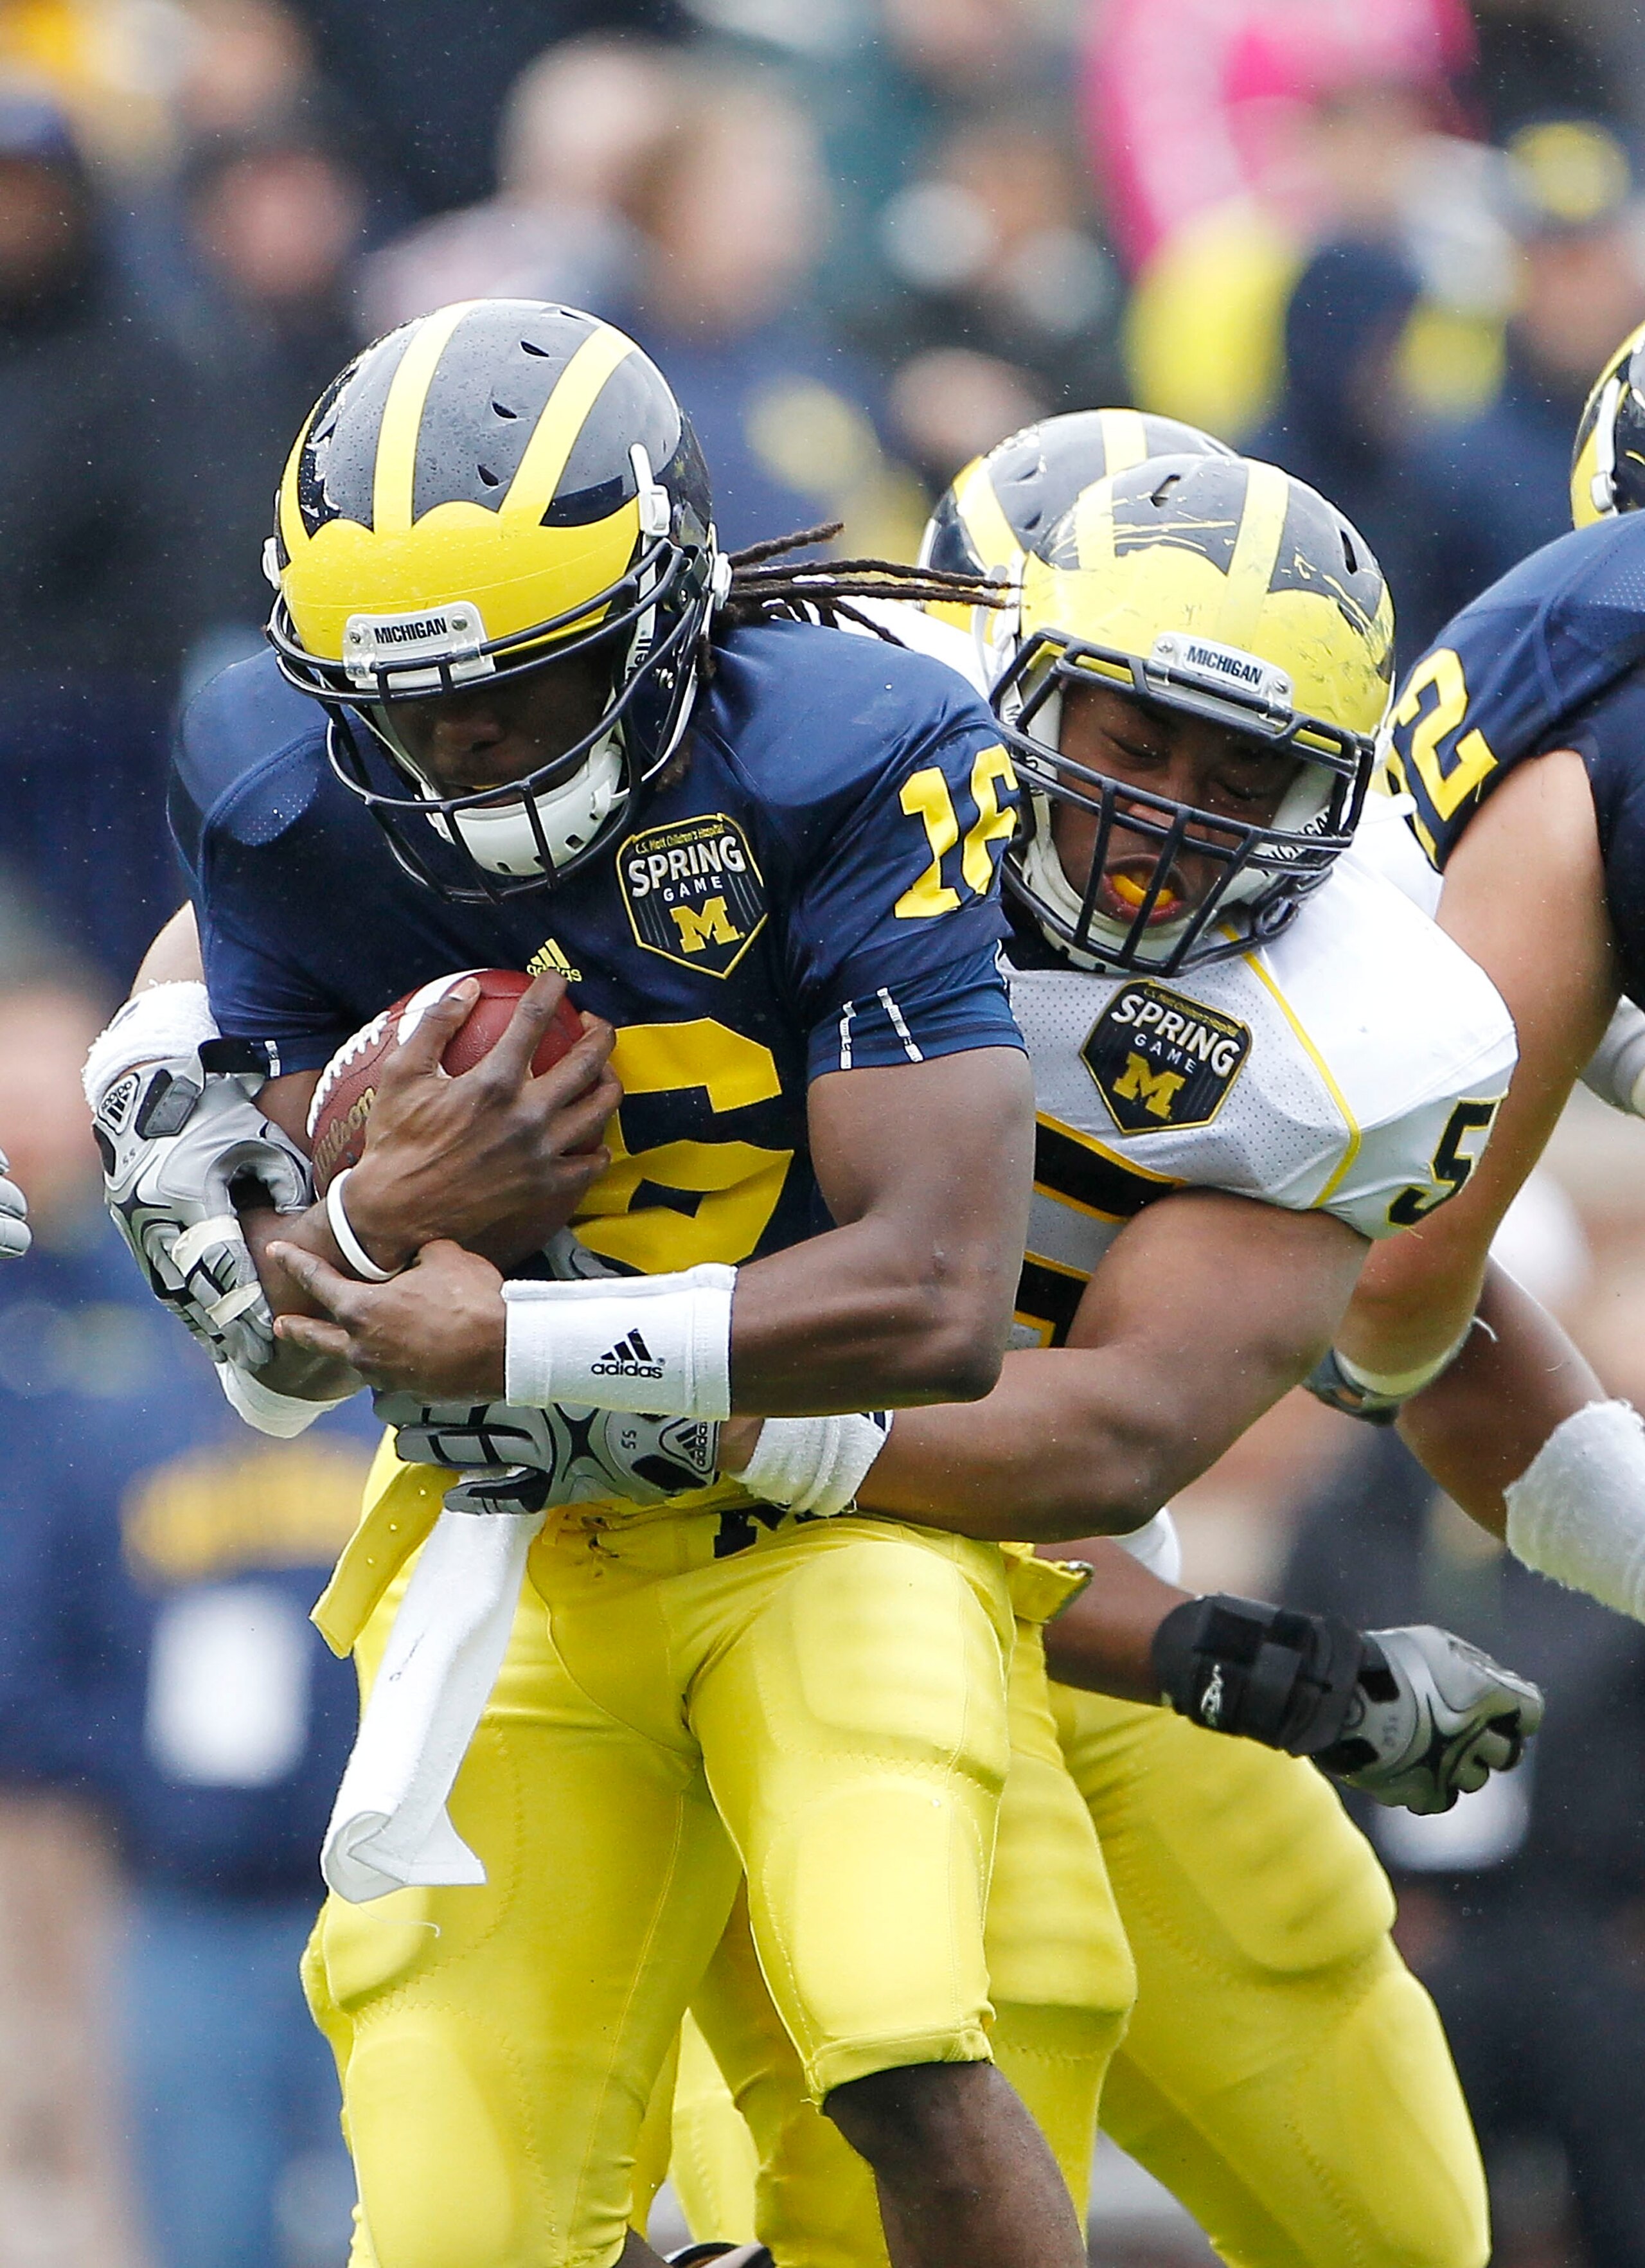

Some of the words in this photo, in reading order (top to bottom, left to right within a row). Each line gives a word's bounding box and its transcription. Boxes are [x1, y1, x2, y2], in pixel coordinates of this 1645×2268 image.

[374, 617, 448, 645] MICHIGAN
[1186, 645, 1263, 686] MICHIGAN
[628, 835, 746, 898] SPRING
[662, 875, 724, 902] GAME
[669, 895, 740, 954] M
[1110, 994, 1240, 1078] SPRING
[1134, 1033, 1197, 1074] GAME
[1112, 1051, 1186, 1120] M
[572, 1017, 795, 1274] 6
[591, 1359, 663, 1379] adidas
